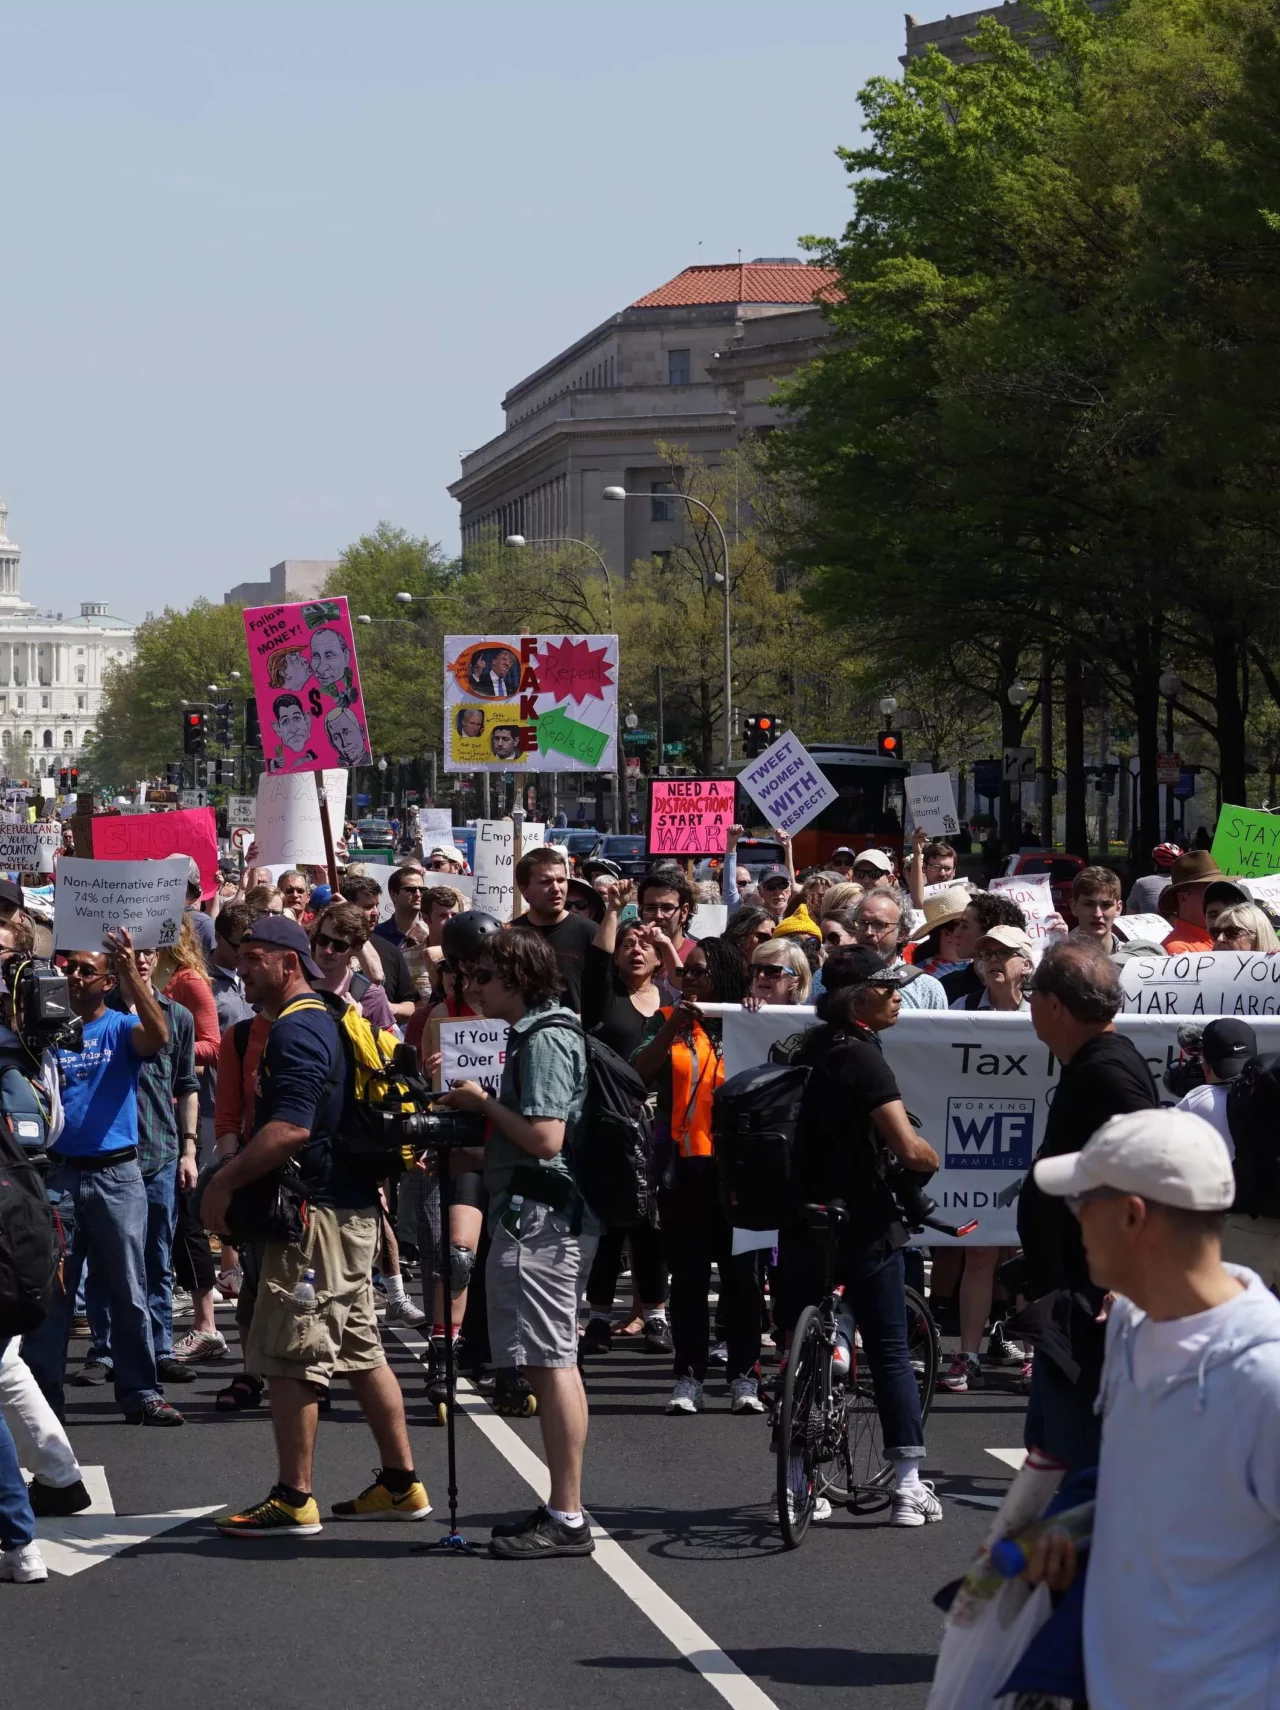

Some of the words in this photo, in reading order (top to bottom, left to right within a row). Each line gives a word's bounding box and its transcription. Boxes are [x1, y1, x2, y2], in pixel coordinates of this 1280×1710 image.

[249, 607, 284, 631] Follow
[263, 620, 286, 637] the
[257, 625, 302, 655] MONEY!
[544, 656, 602, 687] Repeal
[520, 637, 540, 752] FAKE
[538, 715, 605, 764] Replace!
[747, 741, 793, 785] TWEET
[758, 757, 805, 800] WOMEN
[668, 782, 702, 796] NEED
[708, 783, 719, 795] A
[768, 771, 818, 818] WITH
[654, 796, 734, 814] DISTRACTION?
[922, 795, 940, 803] Your
[780, 787, 827, 830] RESPECT!
[915, 806, 941, 817] eturns!
[657, 814, 703, 826] START
[713, 815, 723, 825] A
[943, 822, 956, 830] TAX
[8, 835, 29, 844] YOUR
[33, 836, 58, 846] JOB!
[103, 816, 212, 855] SHOW
[481, 823, 541, 847] Empyee
[656, 826, 726, 852] WAR
[1226, 818, 1280, 847] STAY
[0, 844, 38, 856] COUNTRY
[0, 862, 40, 872] POLITICS!
[63, 875, 154, 890] Non-Alternative
[157, 878, 181, 888] Fact:
[476, 876, 513, 903] Empe
[74, 892, 98, 903] 74%
[102, 894, 114, 904] of
[116, 893, 170, 905] Americans
[1006, 888, 1036, 902] Tax
[75, 906, 105, 918] Want
[108, 909, 120, 919] to
[123, 908, 143, 919] See
[146, 907, 168, 918] Your
[102, 923, 143, 934] Retrns
[160, 929, 175, 939] TAX
[1137, 955, 1216, 986] STOP
[1192, 991, 1205, 1015] A
[454, 1031, 465, 1045] If
[469, 1029, 498, 1044] You
[457, 1054, 494, 1068] Over
[951, 1043, 1029, 1077] Tax
[952, 1102, 1027, 1112] WORKING
[952, 1115, 1026, 1152] WF
[950, 1156, 1024, 1167] FAMILIES
